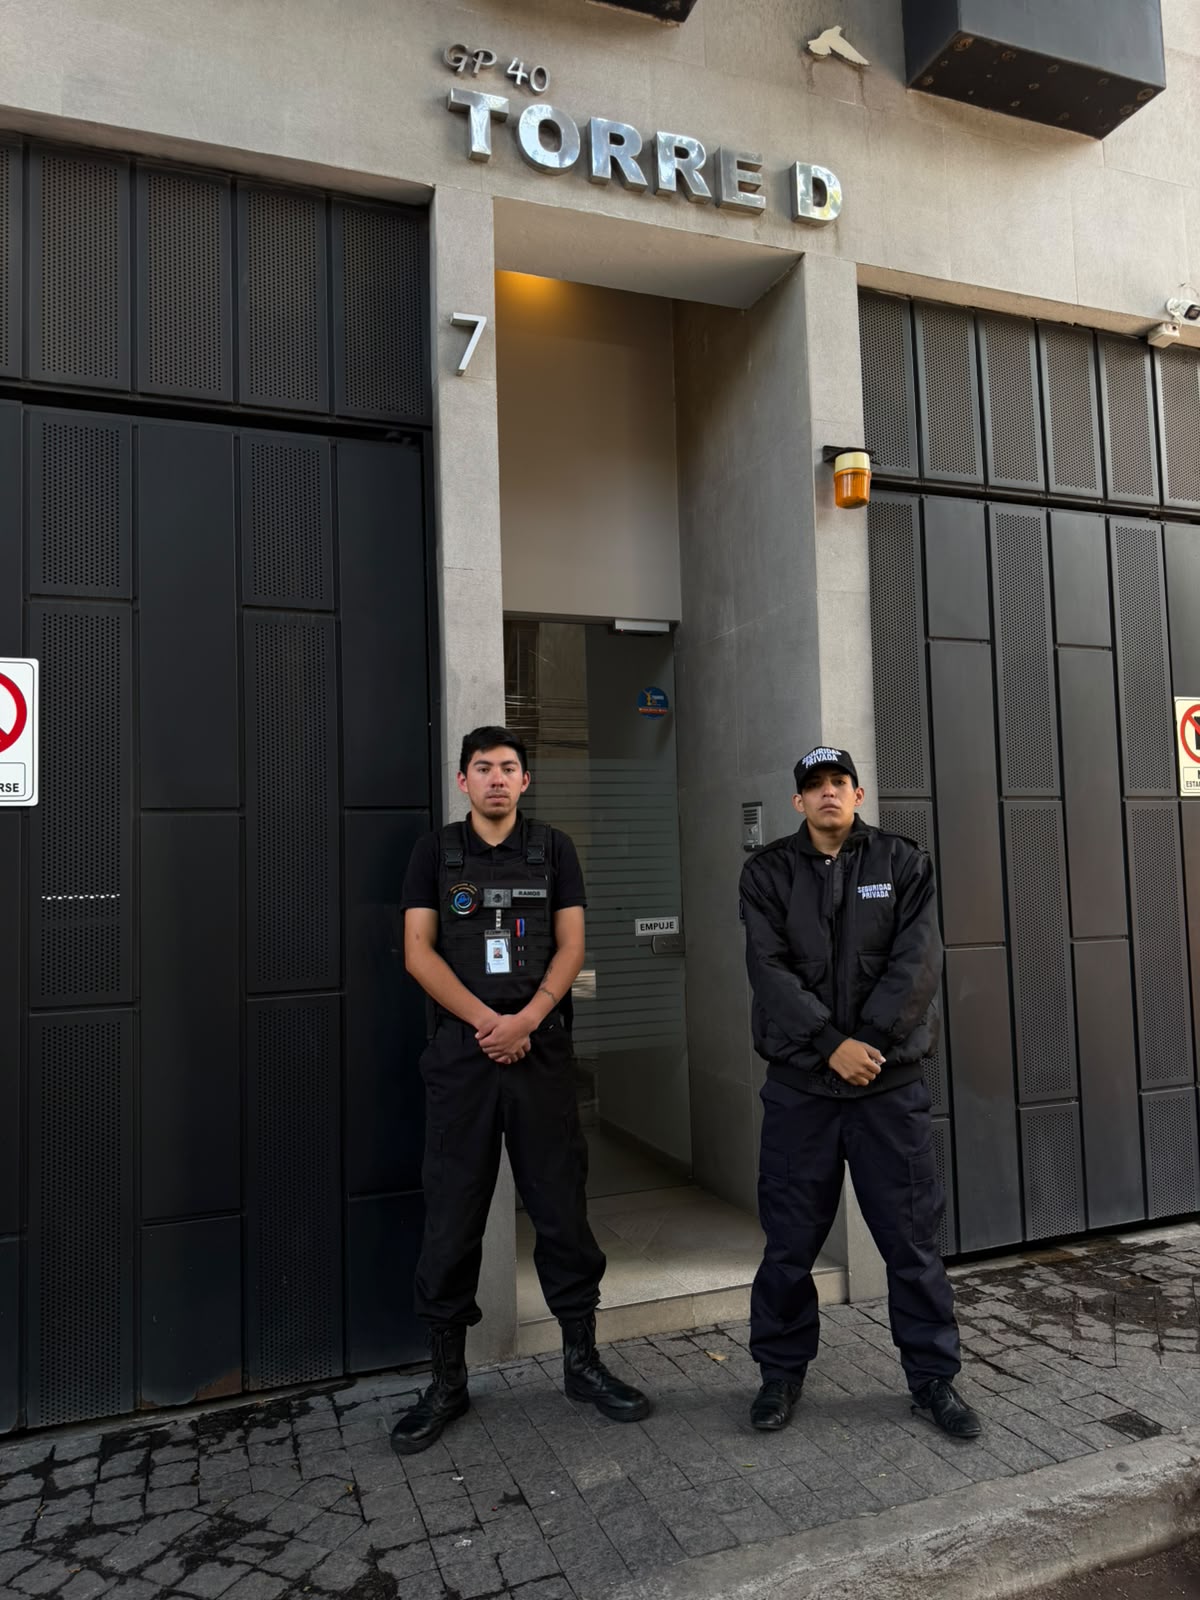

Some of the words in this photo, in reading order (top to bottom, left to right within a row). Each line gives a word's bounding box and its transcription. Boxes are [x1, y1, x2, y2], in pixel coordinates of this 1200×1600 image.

[442, 43, 497, 78] GP
[506, 57, 550, 95] 40
[447, 87, 766, 215] TORRE
[790, 161, 843, 227] D
[450, 312, 487, 376] 7
[806, 754, 838, 769] PRIVADA
[1186, 780, 1200, 788] ESTA
[857, 883, 892, 894] SEGURIDAD
[861, 890, 890, 900] PRIVADA
[639, 920, 675, 932] EMPUJE
